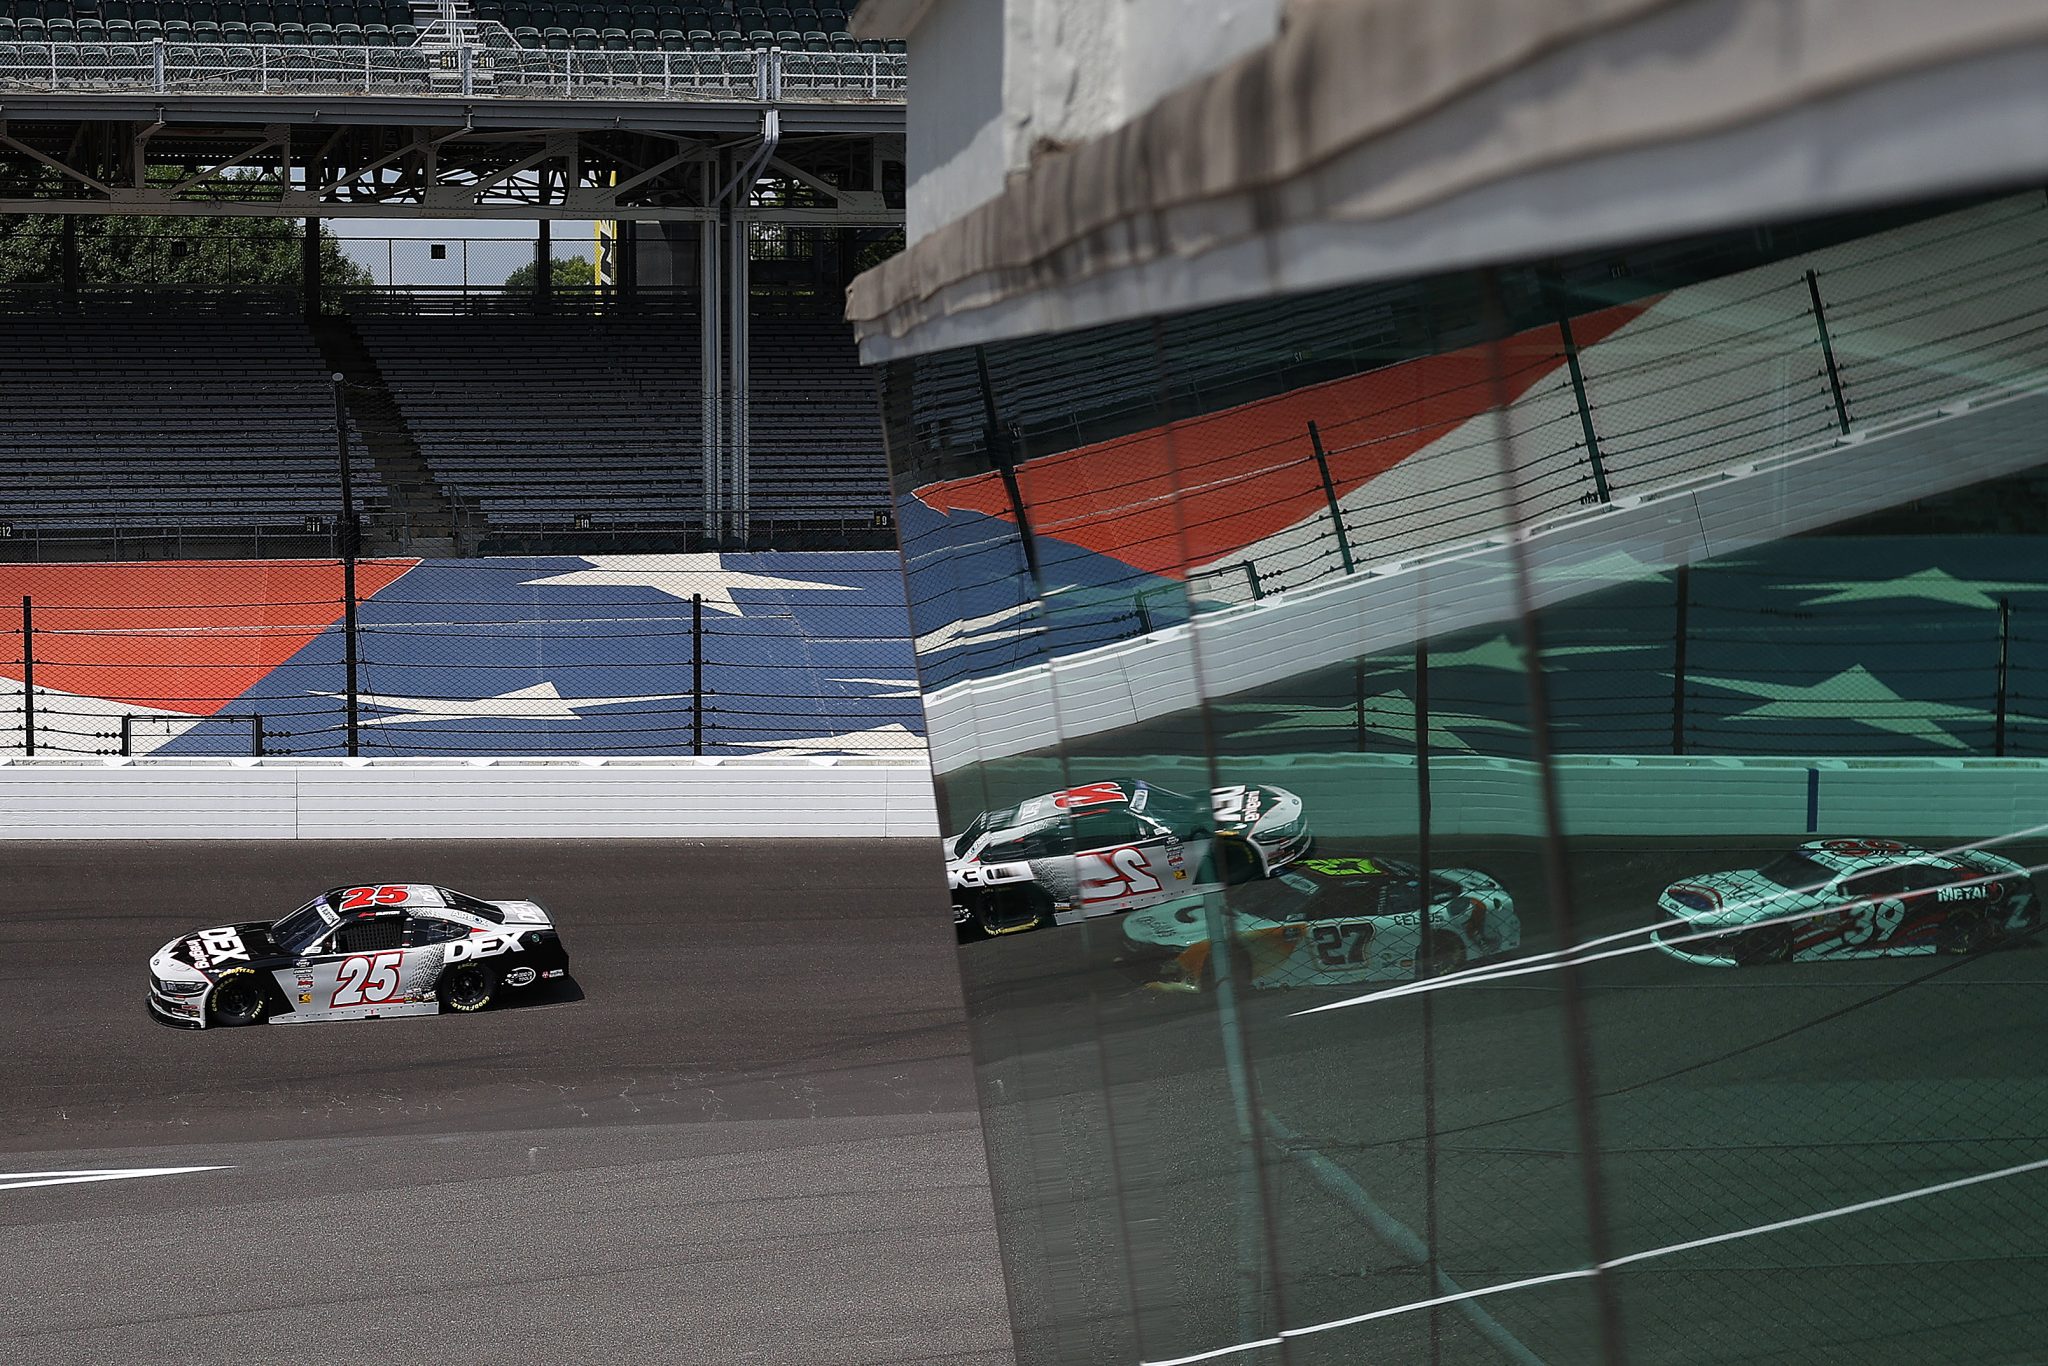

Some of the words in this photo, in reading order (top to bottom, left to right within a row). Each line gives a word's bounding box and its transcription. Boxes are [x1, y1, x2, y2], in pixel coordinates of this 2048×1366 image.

[485, 56, 495, 68] 10
[580, 518, 590, 529] 10
[881, 515, 888, 526] 9
[1, 526, 12, 537] 12
[339, 885, 411, 912] 25
[1937, 885, 1989, 902] METAL
[1393, 913, 1443, 926] CELUS
[1843, 897, 1906, 946] 39
[197, 926, 251, 966] DEX
[443, 930, 525, 964] DEX
[1314, 923, 1374, 965] 27
[218, 966, 256, 978] GOODYEAR
[329, 951, 404, 1008] 25
[450, 996, 490, 1012] GOODYEAR
